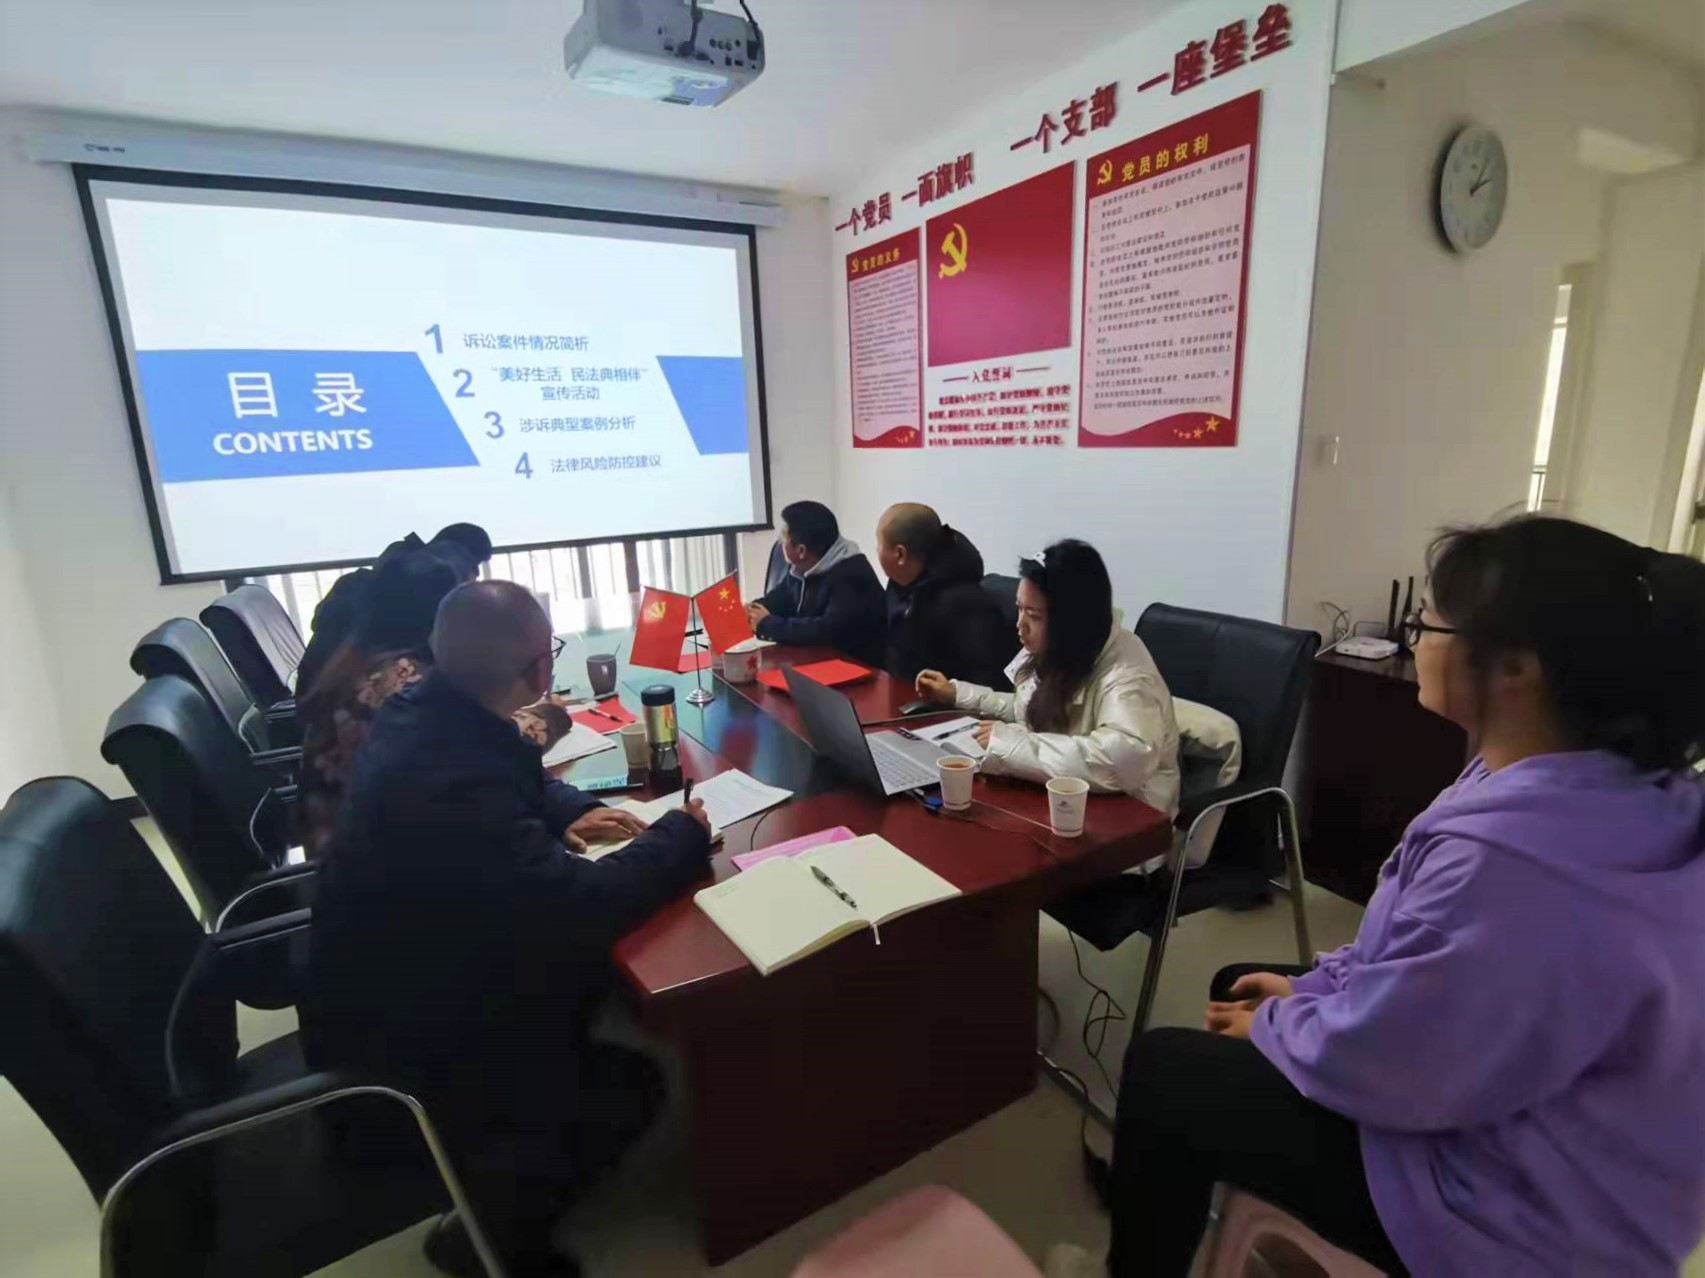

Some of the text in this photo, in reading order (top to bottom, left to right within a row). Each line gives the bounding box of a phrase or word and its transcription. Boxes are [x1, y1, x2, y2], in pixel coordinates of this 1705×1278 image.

[835, 2, 1294, 236] 一个党员 一面旗帜 一个支部 一座堡垒
[1121, 133, 1209, 182] 党员的权利
[424, 323, 589, 354] 1 诉讼案件情况简析
[452, 368, 476, 398] 2
[540, 385, 600, 401] 宣传活动
[483, 411, 636, 439] 3 涉诉典型案例分析
[213, 428, 373, 456] CONTENTS
[514, 452, 662, 479] 4 法律风险防控建议
